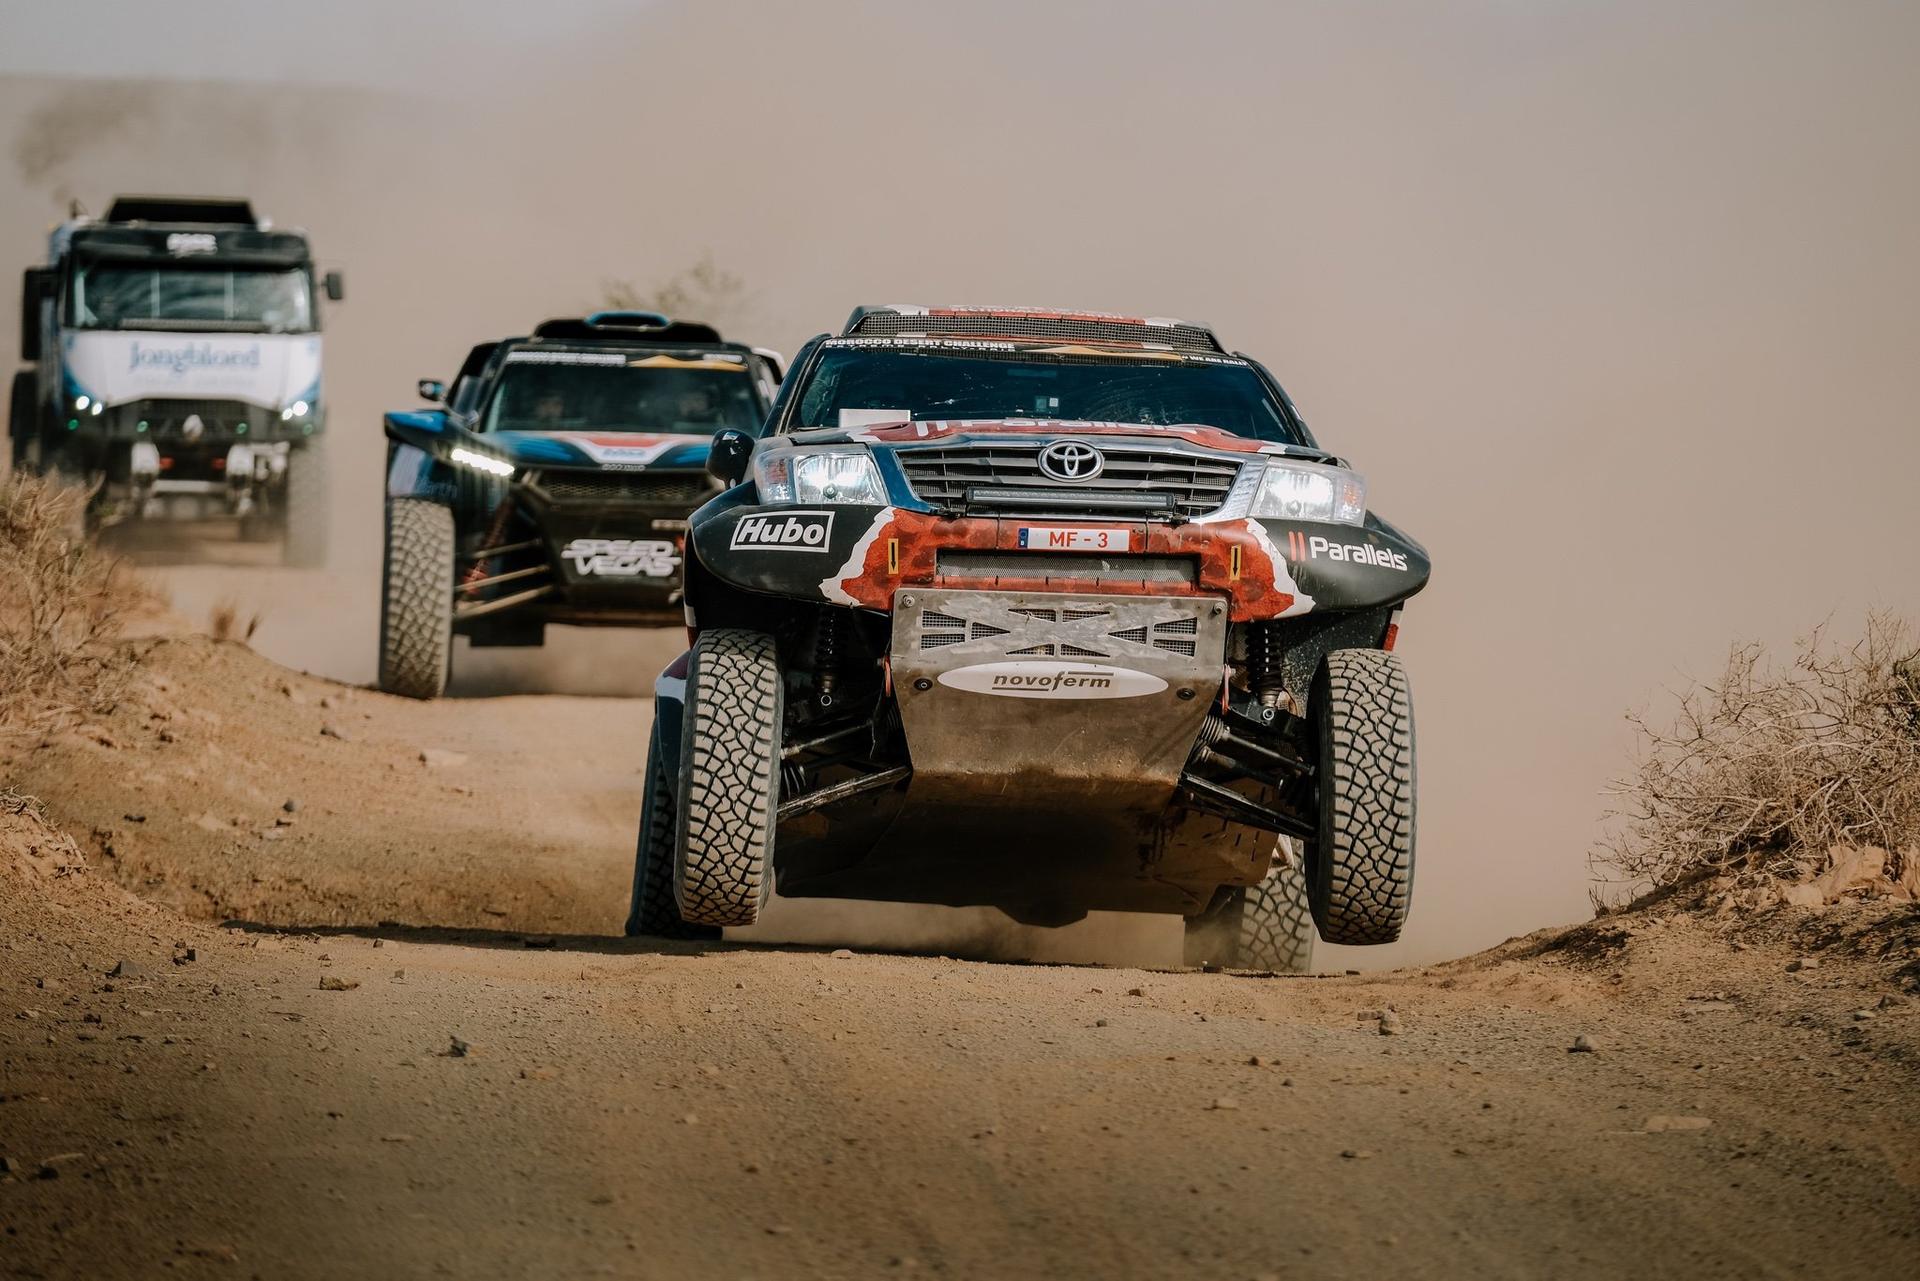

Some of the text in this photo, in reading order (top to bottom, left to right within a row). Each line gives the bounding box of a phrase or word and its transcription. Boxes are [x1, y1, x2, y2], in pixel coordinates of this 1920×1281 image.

[825, 338, 1016, 349] MOROCCO DESERT CHALLENGE
[736, 517, 825, 545] Hubo
[561, 539, 674, 559] SPEED
[1308, 536, 1408, 572] Parallels
[574, 555, 682, 576] VEGAS
[993, 671, 1111, 691] novoferm
